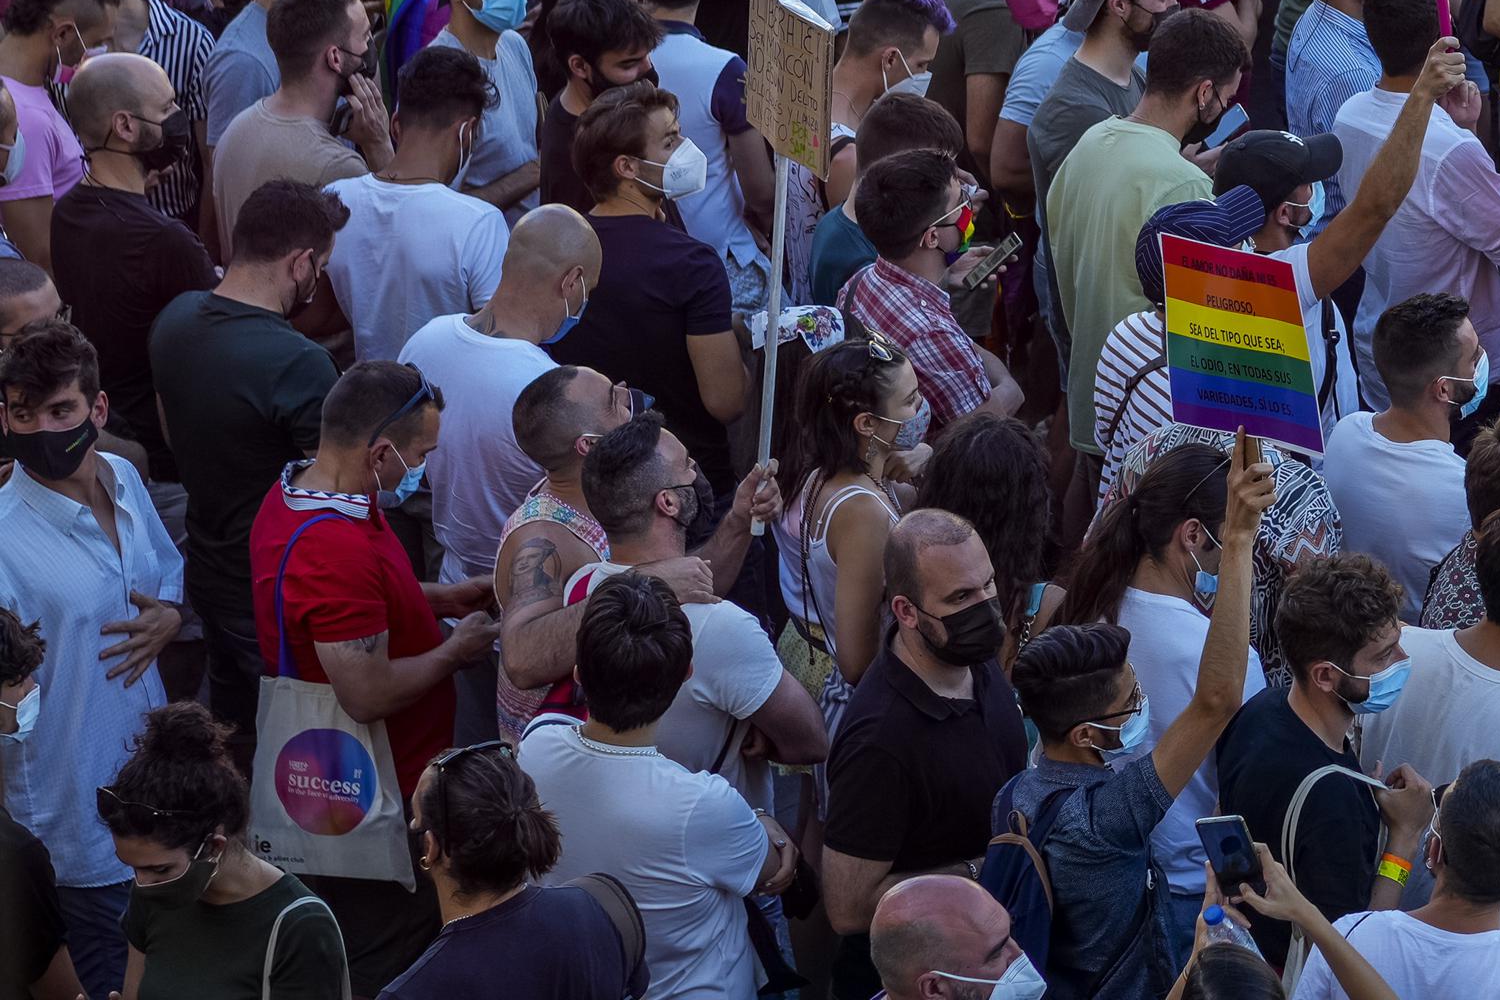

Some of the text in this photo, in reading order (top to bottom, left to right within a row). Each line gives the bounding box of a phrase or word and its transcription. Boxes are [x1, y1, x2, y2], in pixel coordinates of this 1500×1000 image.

[767, 30, 814, 91] MRICÓN
[764, 107, 788, 142] GTO
[1191, 258, 1214, 272] AMOR
[1215, 263, 1228, 277] NO
[1230, 265, 1255, 282] DAÑA
[1206, 294, 1256, 317] PELIGROSO,
[1189, 322, 1285, 354] SEA DEL TIPO QUE SEA;
[1190, 354, 1292, 385] EL ODIO, EN TODAS SUS
[1197, 386, 1294, 417] VARIEDADES, SÍ LO ES.
[288, 773, 361, 796] success
[255, 834, 272, 853] ie
